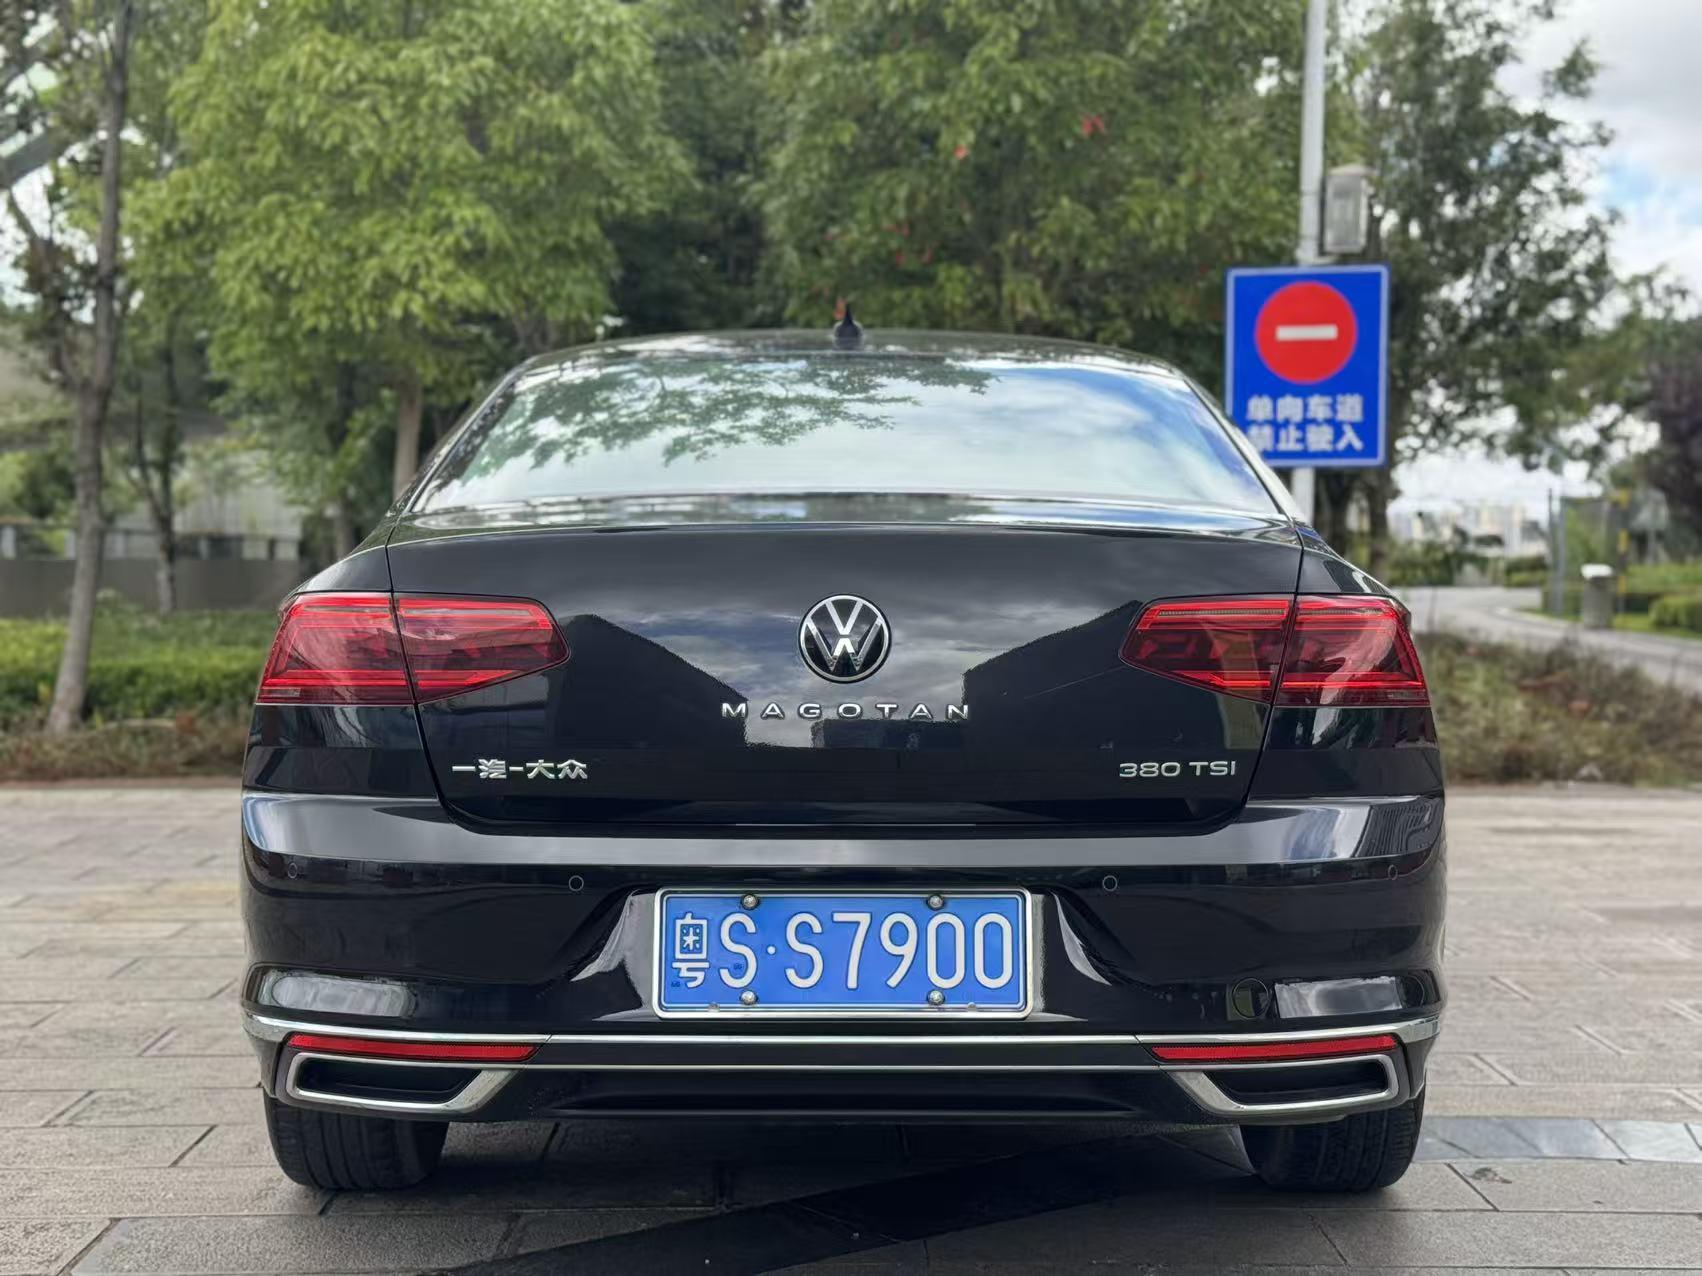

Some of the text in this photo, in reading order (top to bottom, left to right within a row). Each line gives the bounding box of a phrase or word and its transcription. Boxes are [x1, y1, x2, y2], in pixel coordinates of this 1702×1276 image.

[1246, 394, 1364, 422] 单向车道
[721, 702, 970, 719] MAGOTAN
[1119, 761, 1236, 778] 380 TSI
